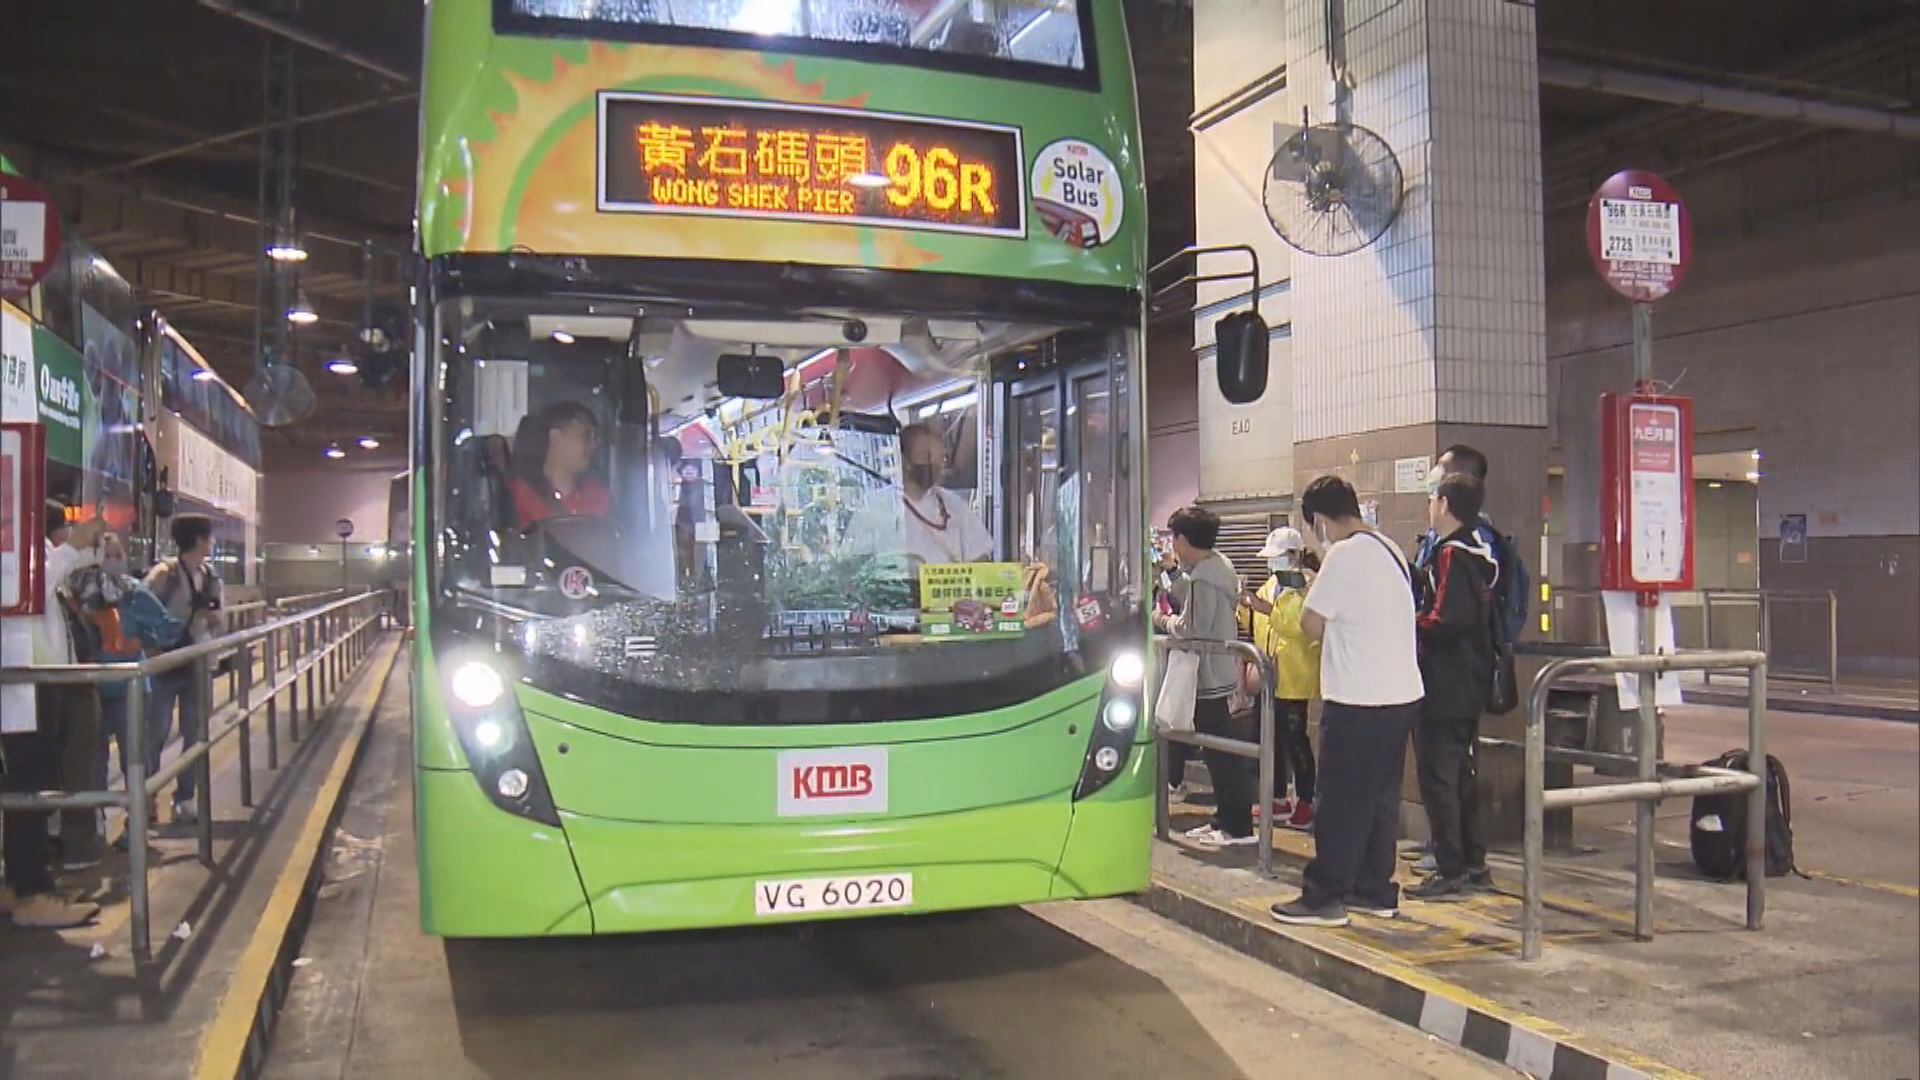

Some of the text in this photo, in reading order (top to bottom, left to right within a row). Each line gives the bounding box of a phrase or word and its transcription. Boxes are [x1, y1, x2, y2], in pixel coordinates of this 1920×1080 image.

[638, 123, 867, 184] 黃石碼頭
[1053, 157, 1105, 184] Solar
[652, 177, 855, 213] WONG SHEK PIER
[886, 143, 995, 215] 96R
[1063, 182, 1099, 207] Bus
[793, 764, 873, 799] KMB
[764, 877, 905, 909] VG 6020
